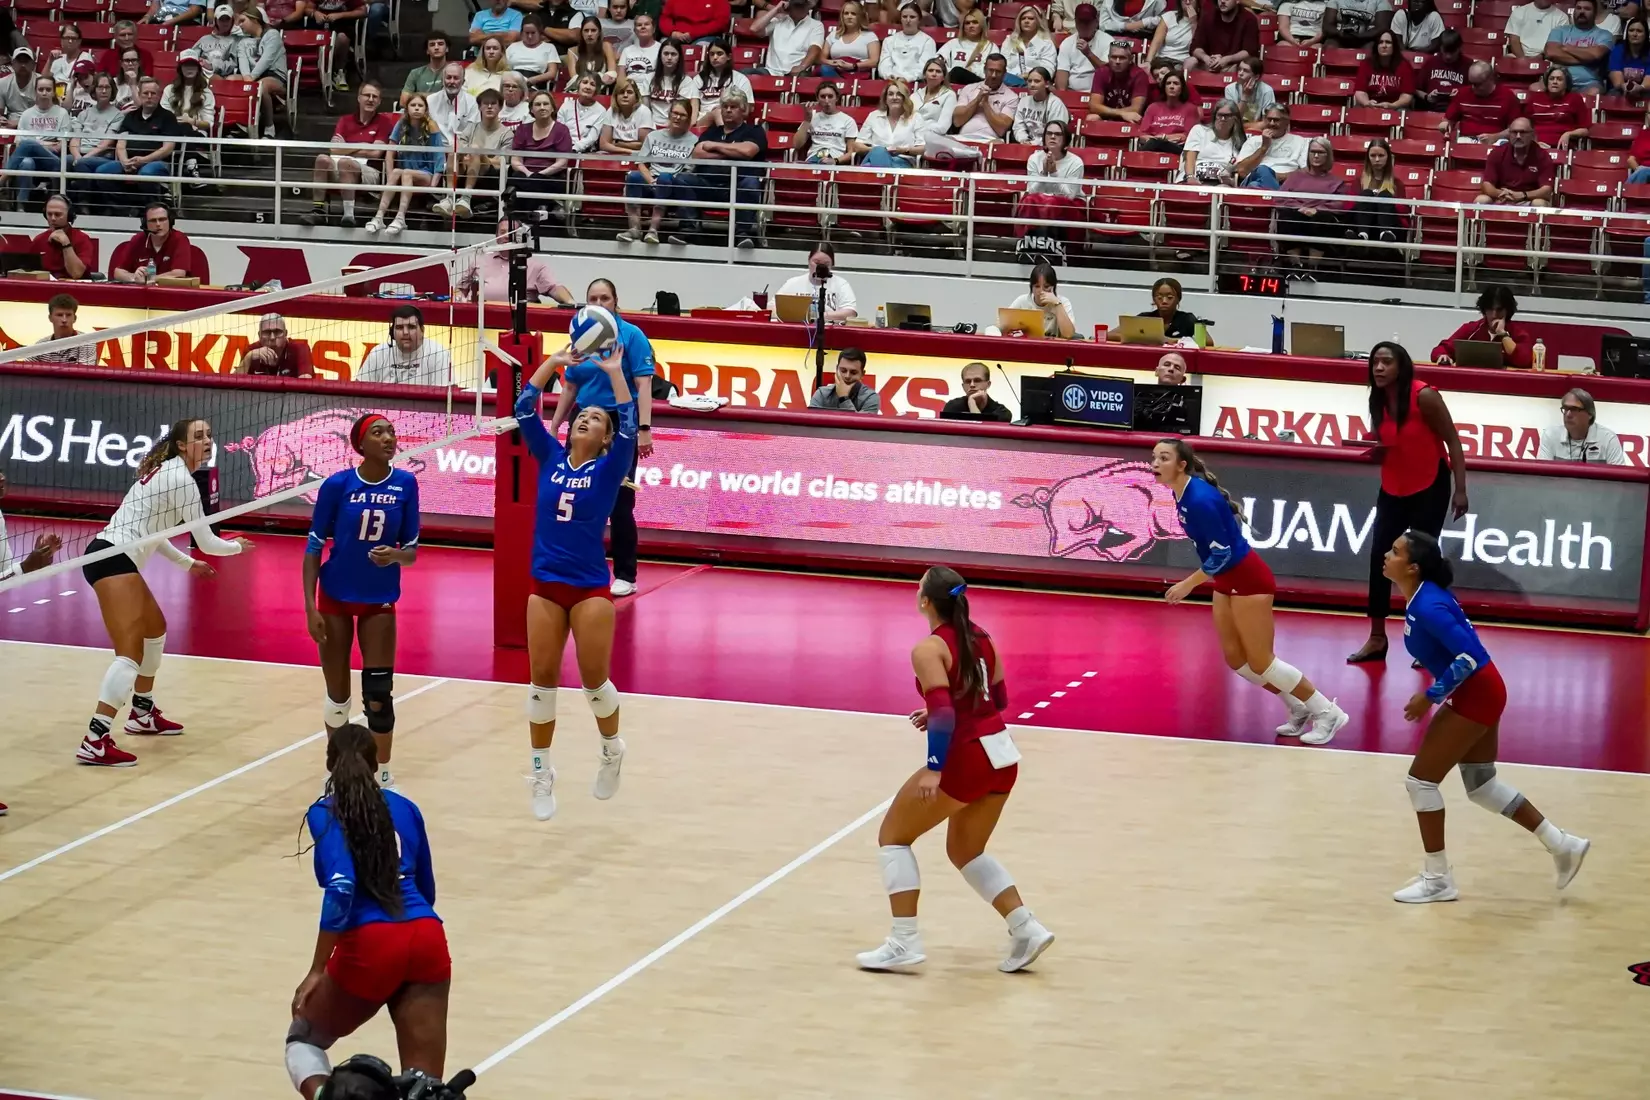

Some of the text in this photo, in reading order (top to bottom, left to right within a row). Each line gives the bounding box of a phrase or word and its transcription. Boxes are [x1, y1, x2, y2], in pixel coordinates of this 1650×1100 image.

[292, 185, 301, 195] 6
[255, 212, 265, 223] 5
[1239, 275, 1280, 293] 7:14
[1065, 387, 1085, 410] SEC
[1090, 390, 1124, 402] VIDEO
[1090, 401, 1124, 412] REVIEW
[436, 448, 1003, 511] Wor re for world class athletes
[550, 471, 592, 489] LA TECH
[349, 493, 397, 504] LA TECH
[556, 491, 576, 522] 5
[358, 508, 386, 542] 13
[1438, 512, 1613, 571] Health
